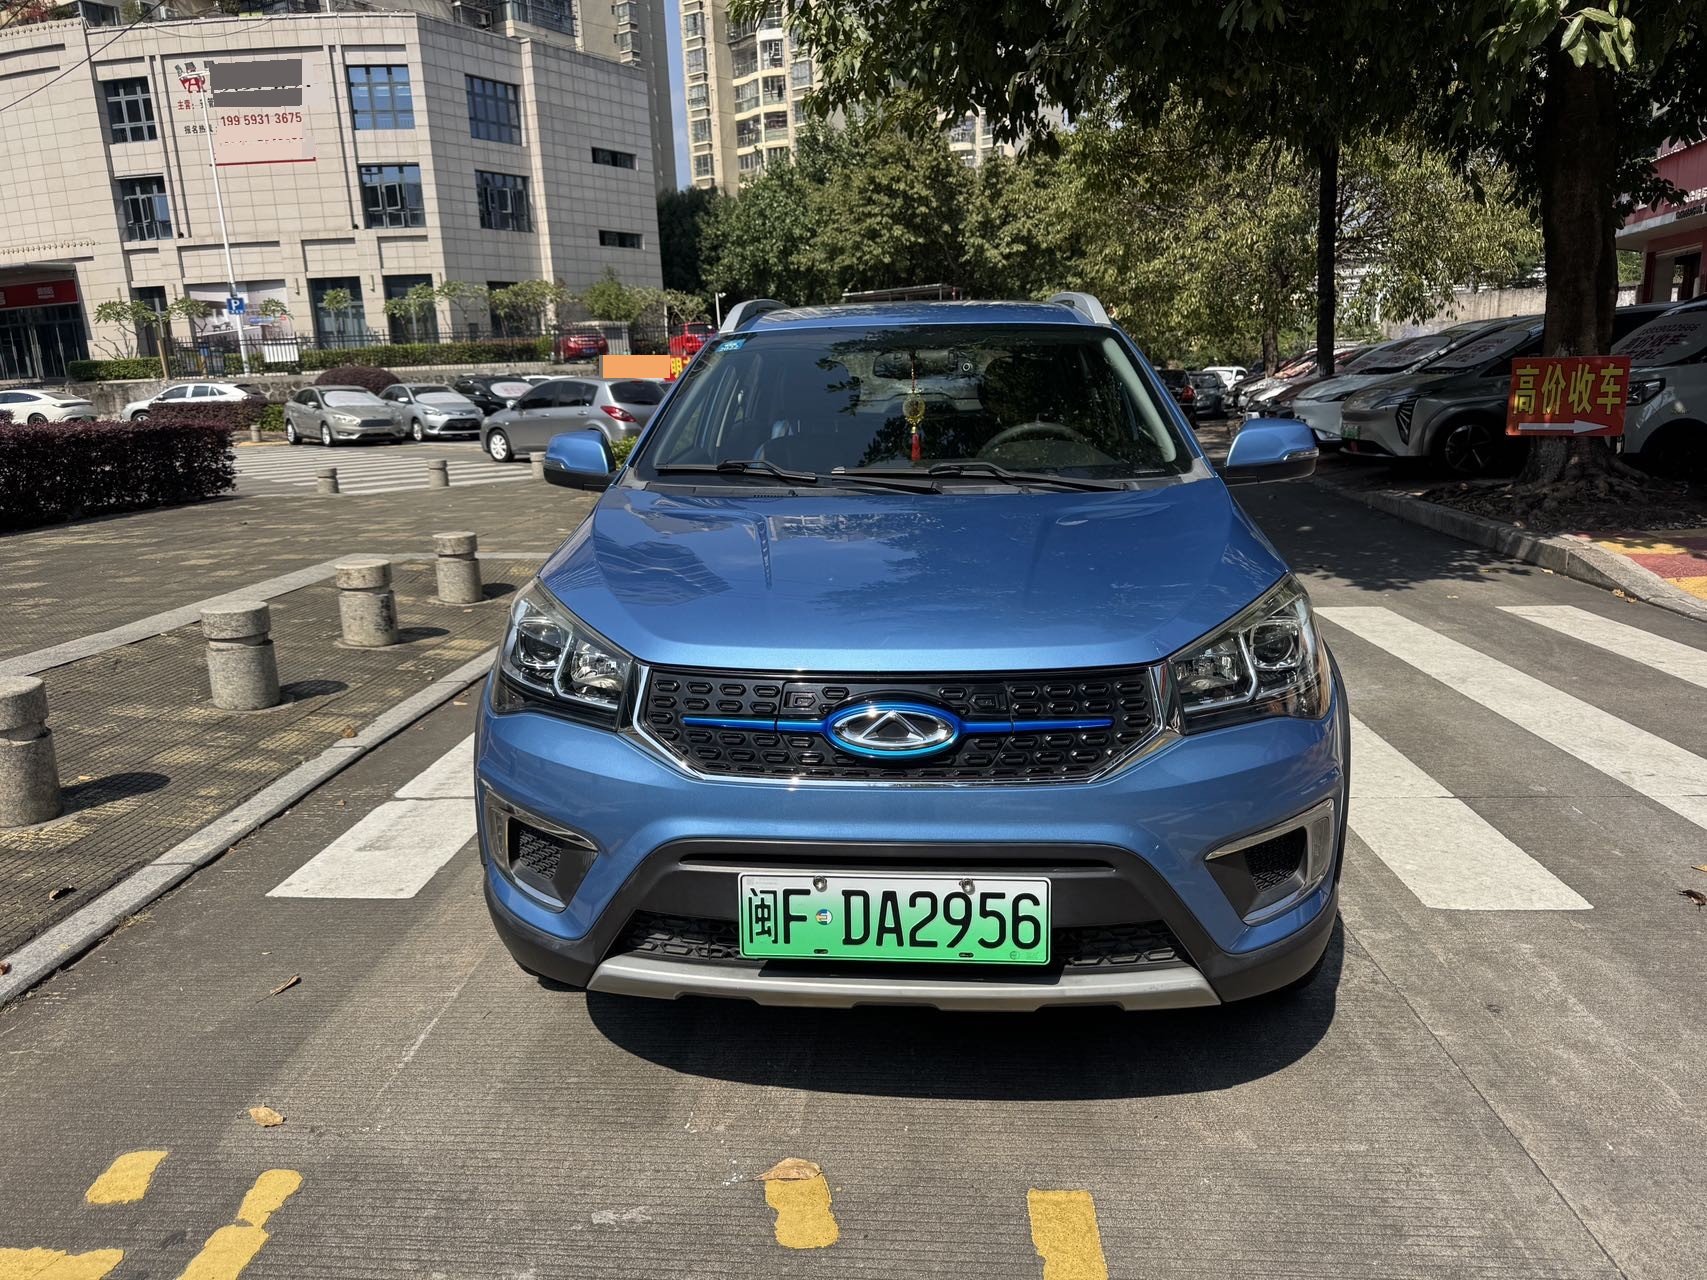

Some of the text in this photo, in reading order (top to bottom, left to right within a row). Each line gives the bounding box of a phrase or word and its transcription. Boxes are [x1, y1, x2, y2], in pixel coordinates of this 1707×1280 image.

[221, 111, 302, 127] 199 5931 3675
[231, 299, 240, 310] P
[671, 357, 690, 378] 明
[1513, 363, 1624, 414] 高价收车
[749, 888, 1041, 949] 闽F DA2956
